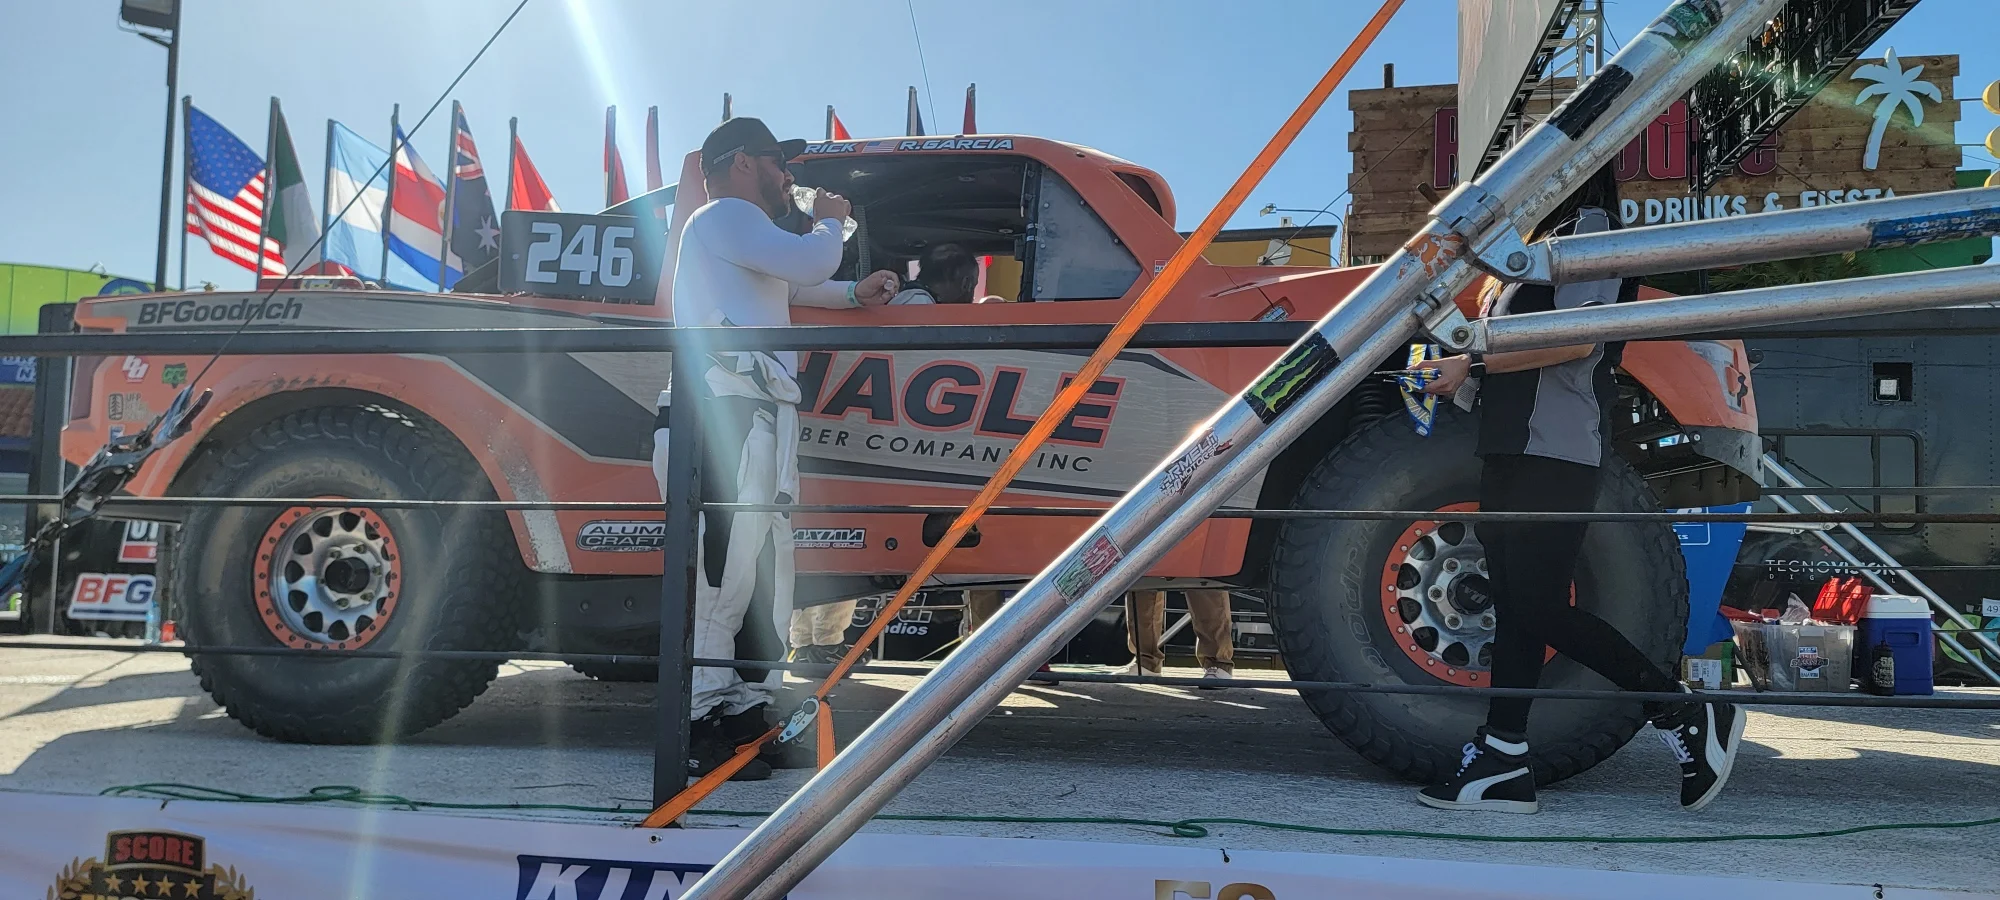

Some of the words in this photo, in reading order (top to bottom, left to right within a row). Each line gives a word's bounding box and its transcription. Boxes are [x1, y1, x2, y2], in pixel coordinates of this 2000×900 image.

[899, 139, 1014, 151] R.GARCIA
[1645, 194, 1747, 225] DRINKS
[1763, 192, 1784, 213] &
[525, 222, 634, 287] 246
[137, 298, 303, 325] BFGoodrich
[800, 427, 850, 447] BER
[1037, 452, 1093, 472] INC
[586, 536, 665, 545] CRAFT
[793, 529, 866, 543] AXIMA
[1765, 559, 1896, 575] TECNOVION
[1986, 605, 2000, 613] 49
[885, 623, 928, 635] dios
[114, 835, 196, 866] SCORE
[524, 862, 705, 900] KIN
